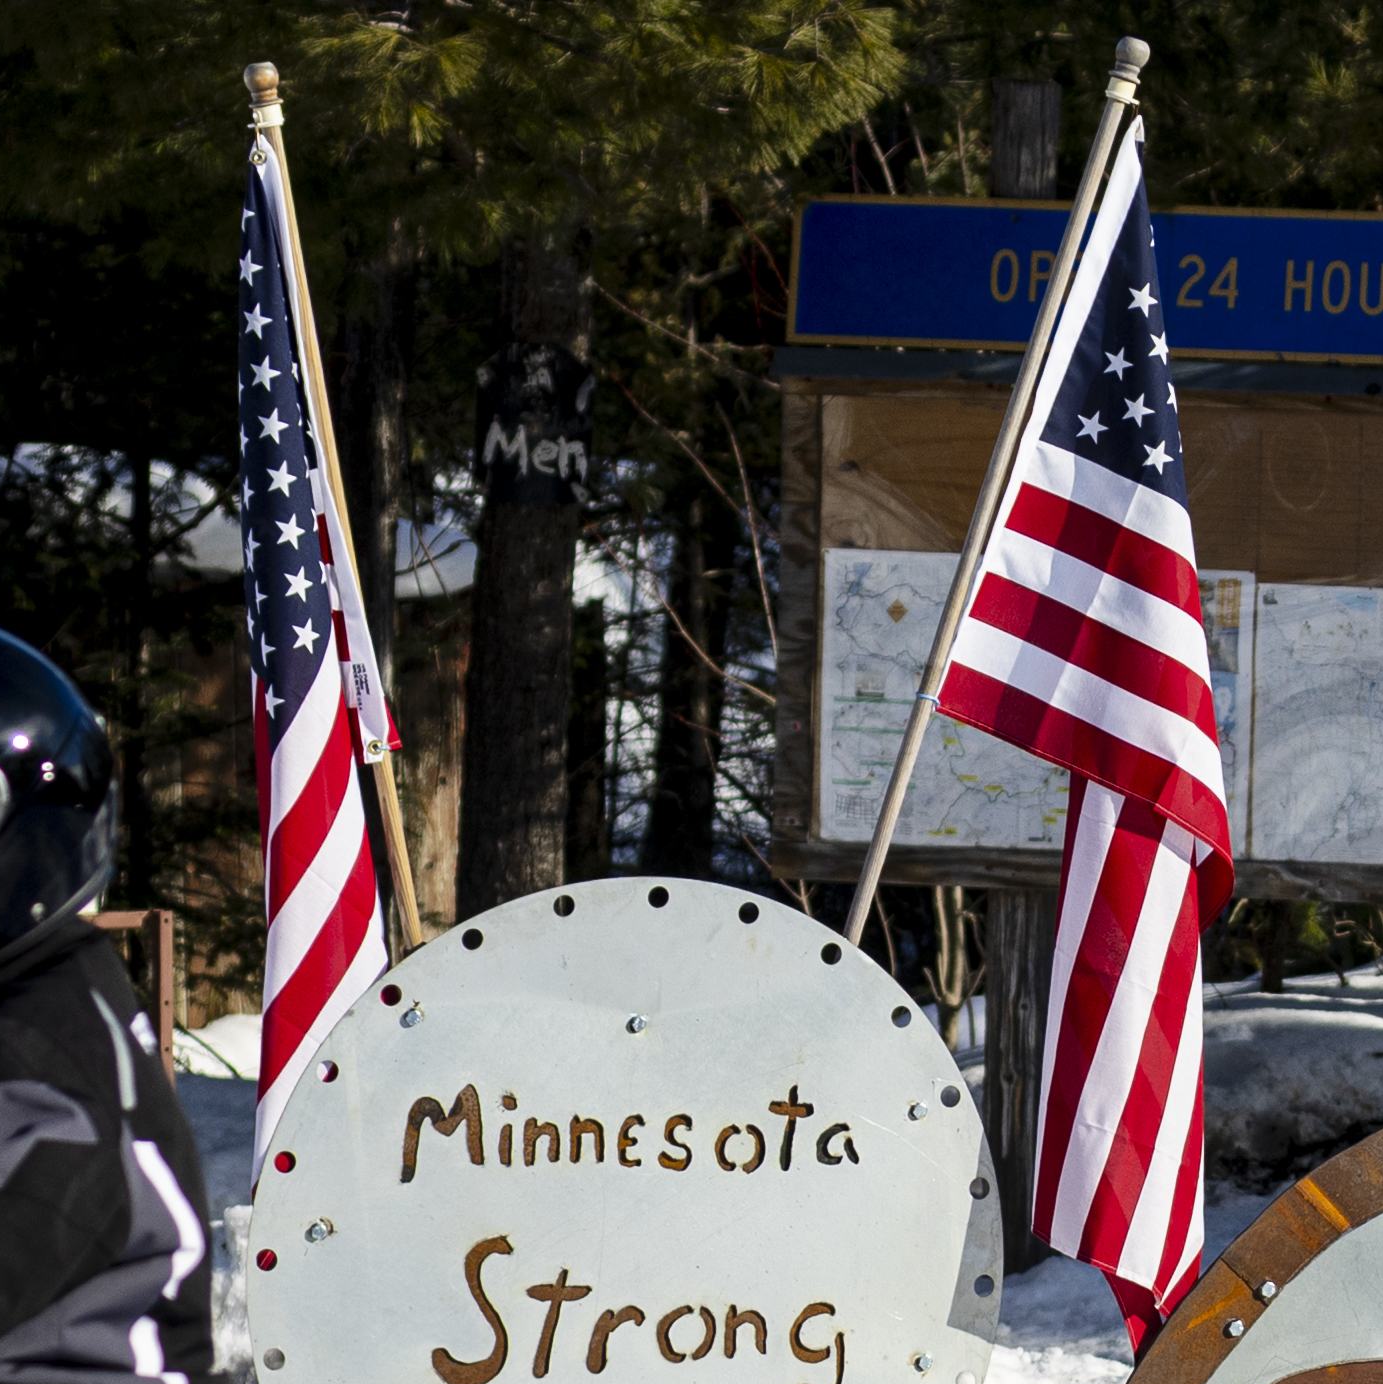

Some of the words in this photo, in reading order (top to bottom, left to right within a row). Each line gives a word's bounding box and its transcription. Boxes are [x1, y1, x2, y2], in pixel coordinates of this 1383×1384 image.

[1176, 253, 1239, 309] 24
[482, 415, 588, 484] Men
[400, 1083, 859, 1183] Minnesota
